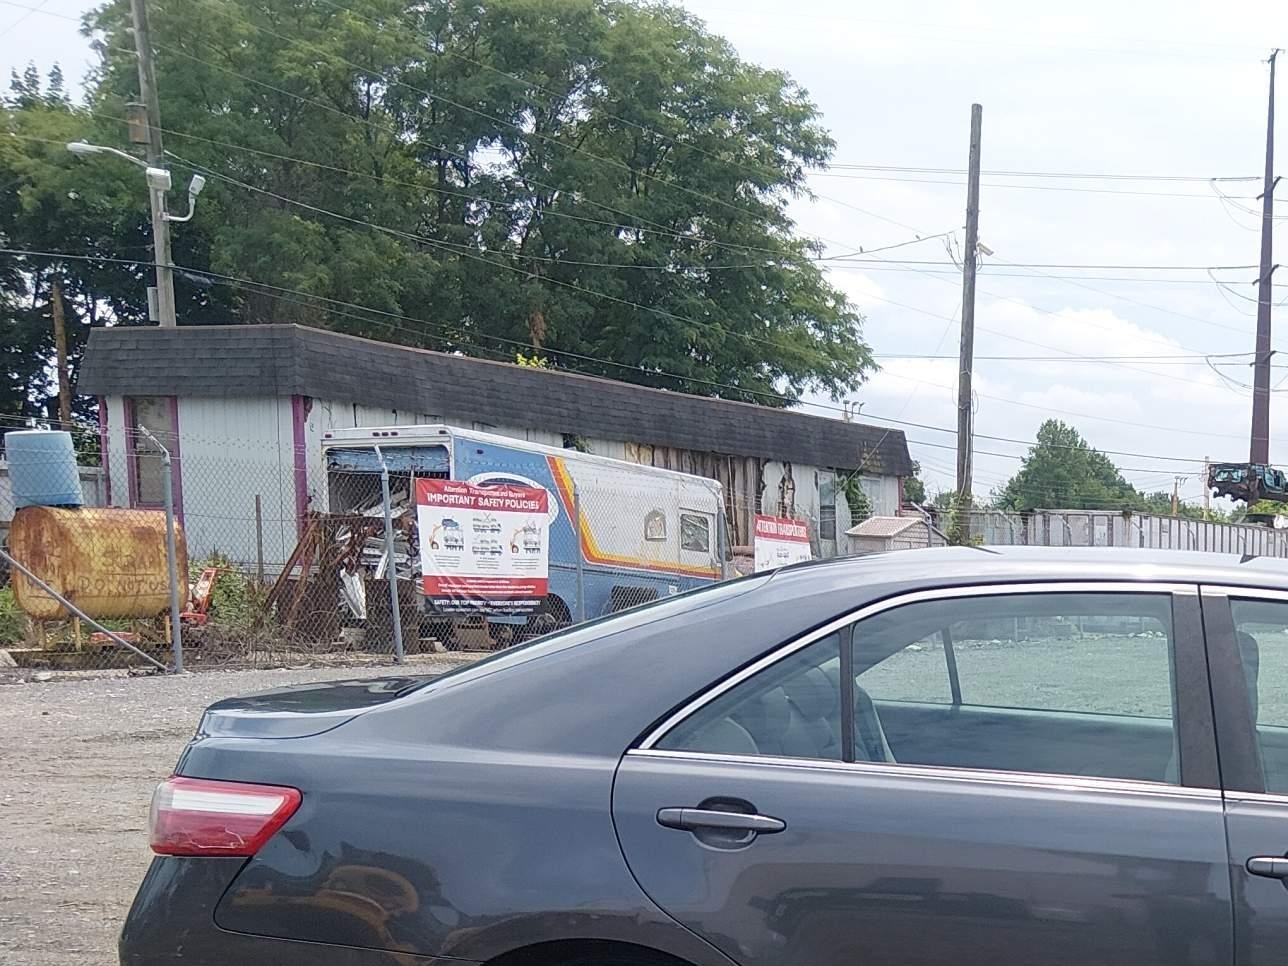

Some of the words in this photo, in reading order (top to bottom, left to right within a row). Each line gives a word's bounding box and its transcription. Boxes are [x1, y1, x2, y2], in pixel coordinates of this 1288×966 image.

[426, 492, 475, 505] IMPORTANT
[478, 497, 505, 508] SAFETY
[505, 499, 540, 510] POLICIES
